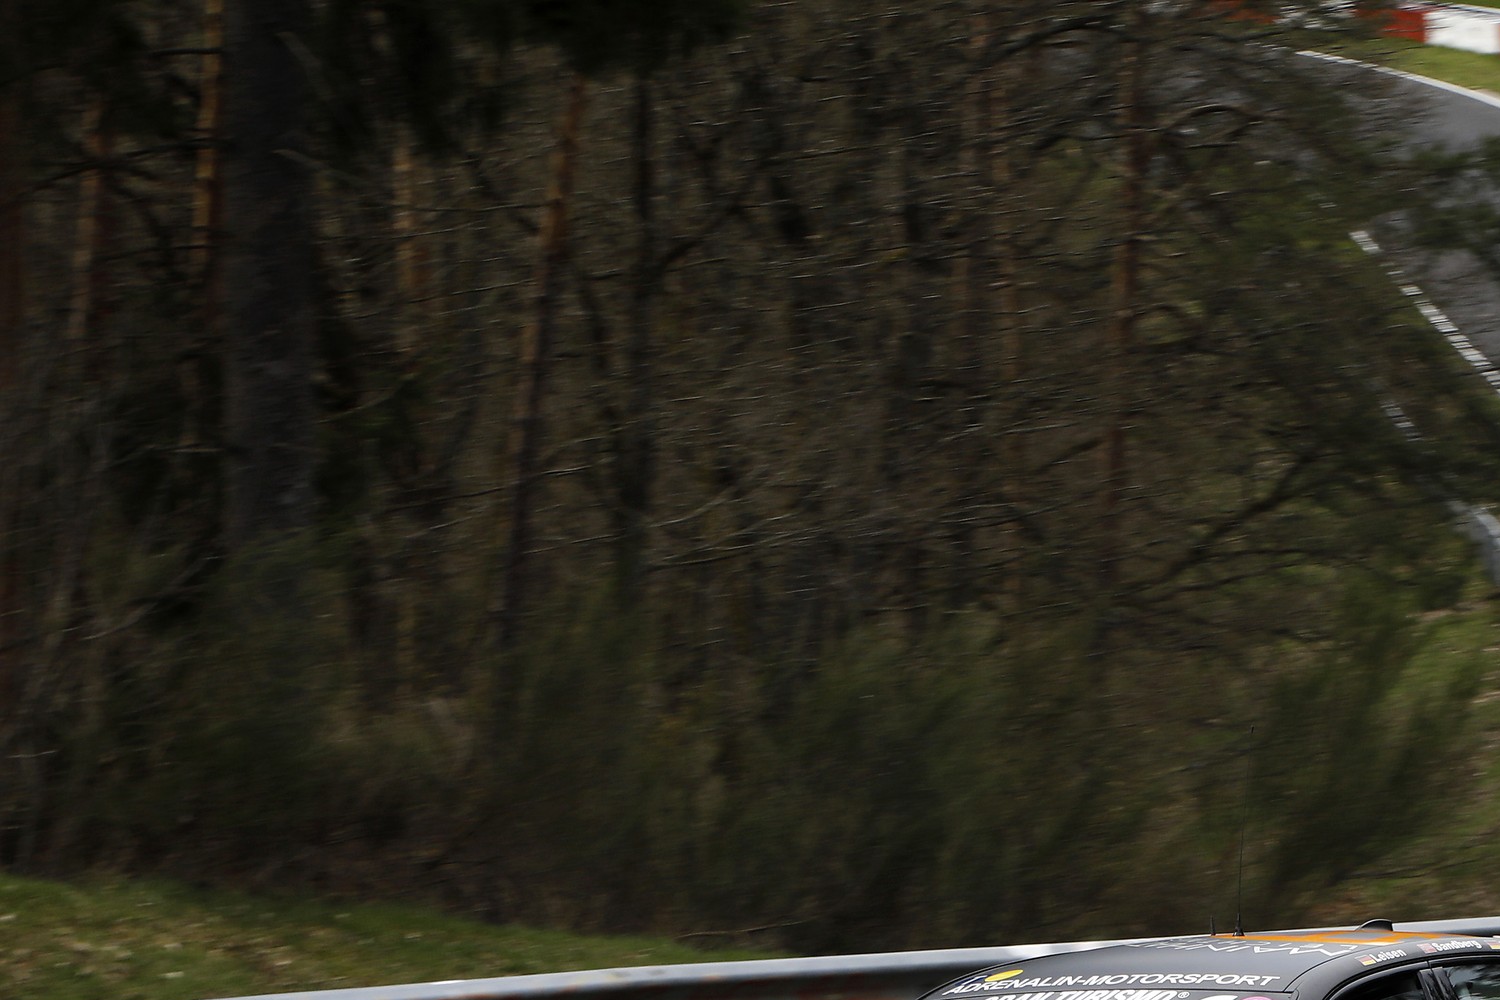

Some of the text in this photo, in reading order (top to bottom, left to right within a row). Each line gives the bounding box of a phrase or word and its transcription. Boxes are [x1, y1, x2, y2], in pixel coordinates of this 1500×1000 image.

[1432, 939, 1483, 952] Sandberg
[1369, 949, 1408, 963] Leisen
[942, 974, 1281, 995] ADRENALIN-MOTORSPORT
